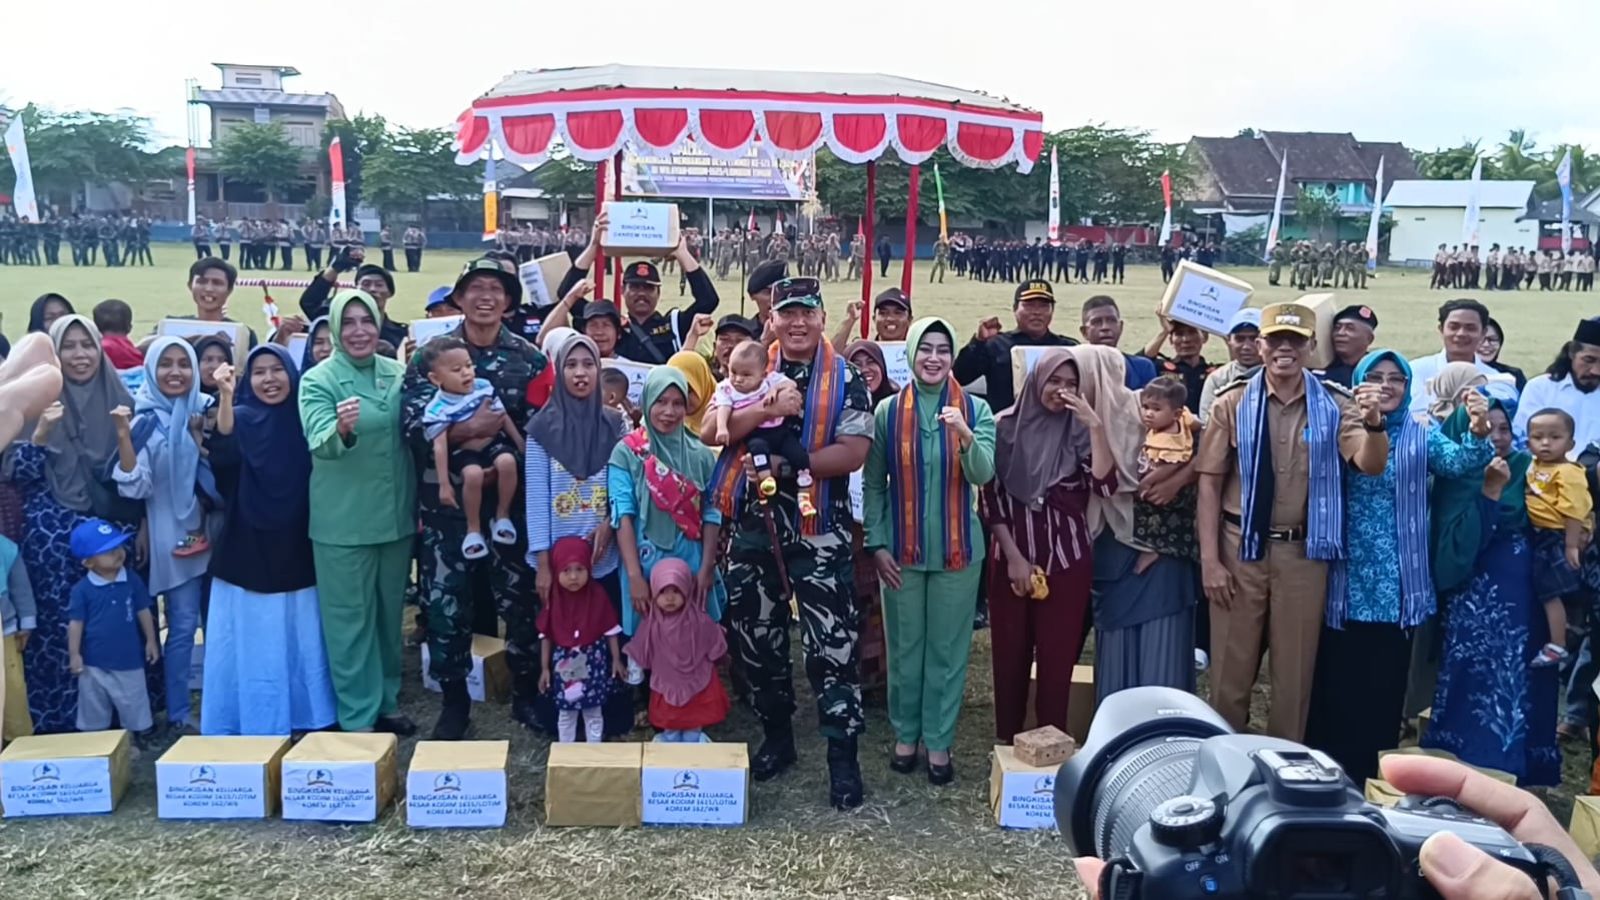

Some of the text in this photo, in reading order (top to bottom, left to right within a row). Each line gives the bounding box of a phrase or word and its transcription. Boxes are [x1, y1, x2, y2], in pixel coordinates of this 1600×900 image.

[1187, 298, 1220, 314] BINGKISAN
[60, 781, 98, 789] KELUARGA
[168, 785, 213, 793] BINGKISAN
[697, 798, 737, 806] 1615/LOTIM
[1012, 795, 1053, 803] BINGKISA
[459, 800, 501, 808] 1615/LOTIM
[1214, 854, 1229, 864] ON
[1184, 861, 1200, 872] OFF
